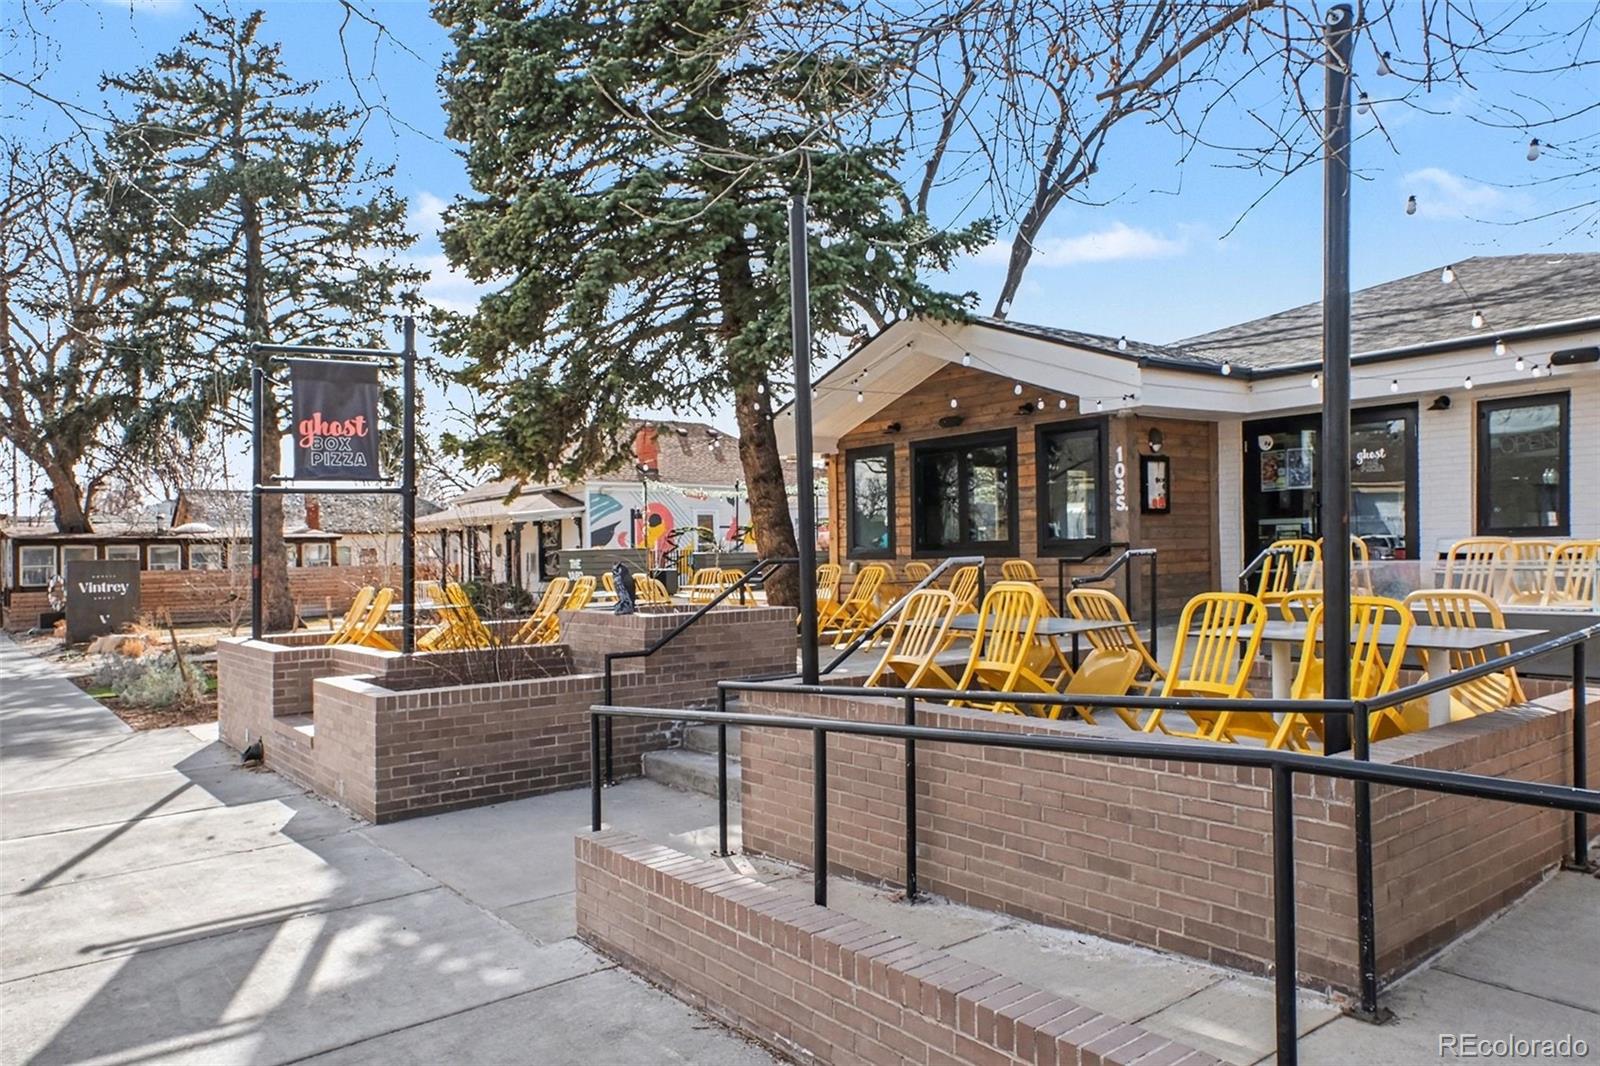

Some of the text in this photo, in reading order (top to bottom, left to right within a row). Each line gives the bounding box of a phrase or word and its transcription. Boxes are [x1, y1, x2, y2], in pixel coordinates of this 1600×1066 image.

[299, 412, 368, 448] ghost
[311, 436, 352, 451] BOX
[311, 452, 367, 466] PIZZA
[1356, 448, 1386, 465] ghost
[78, 582, 129, 596] Vintrey
